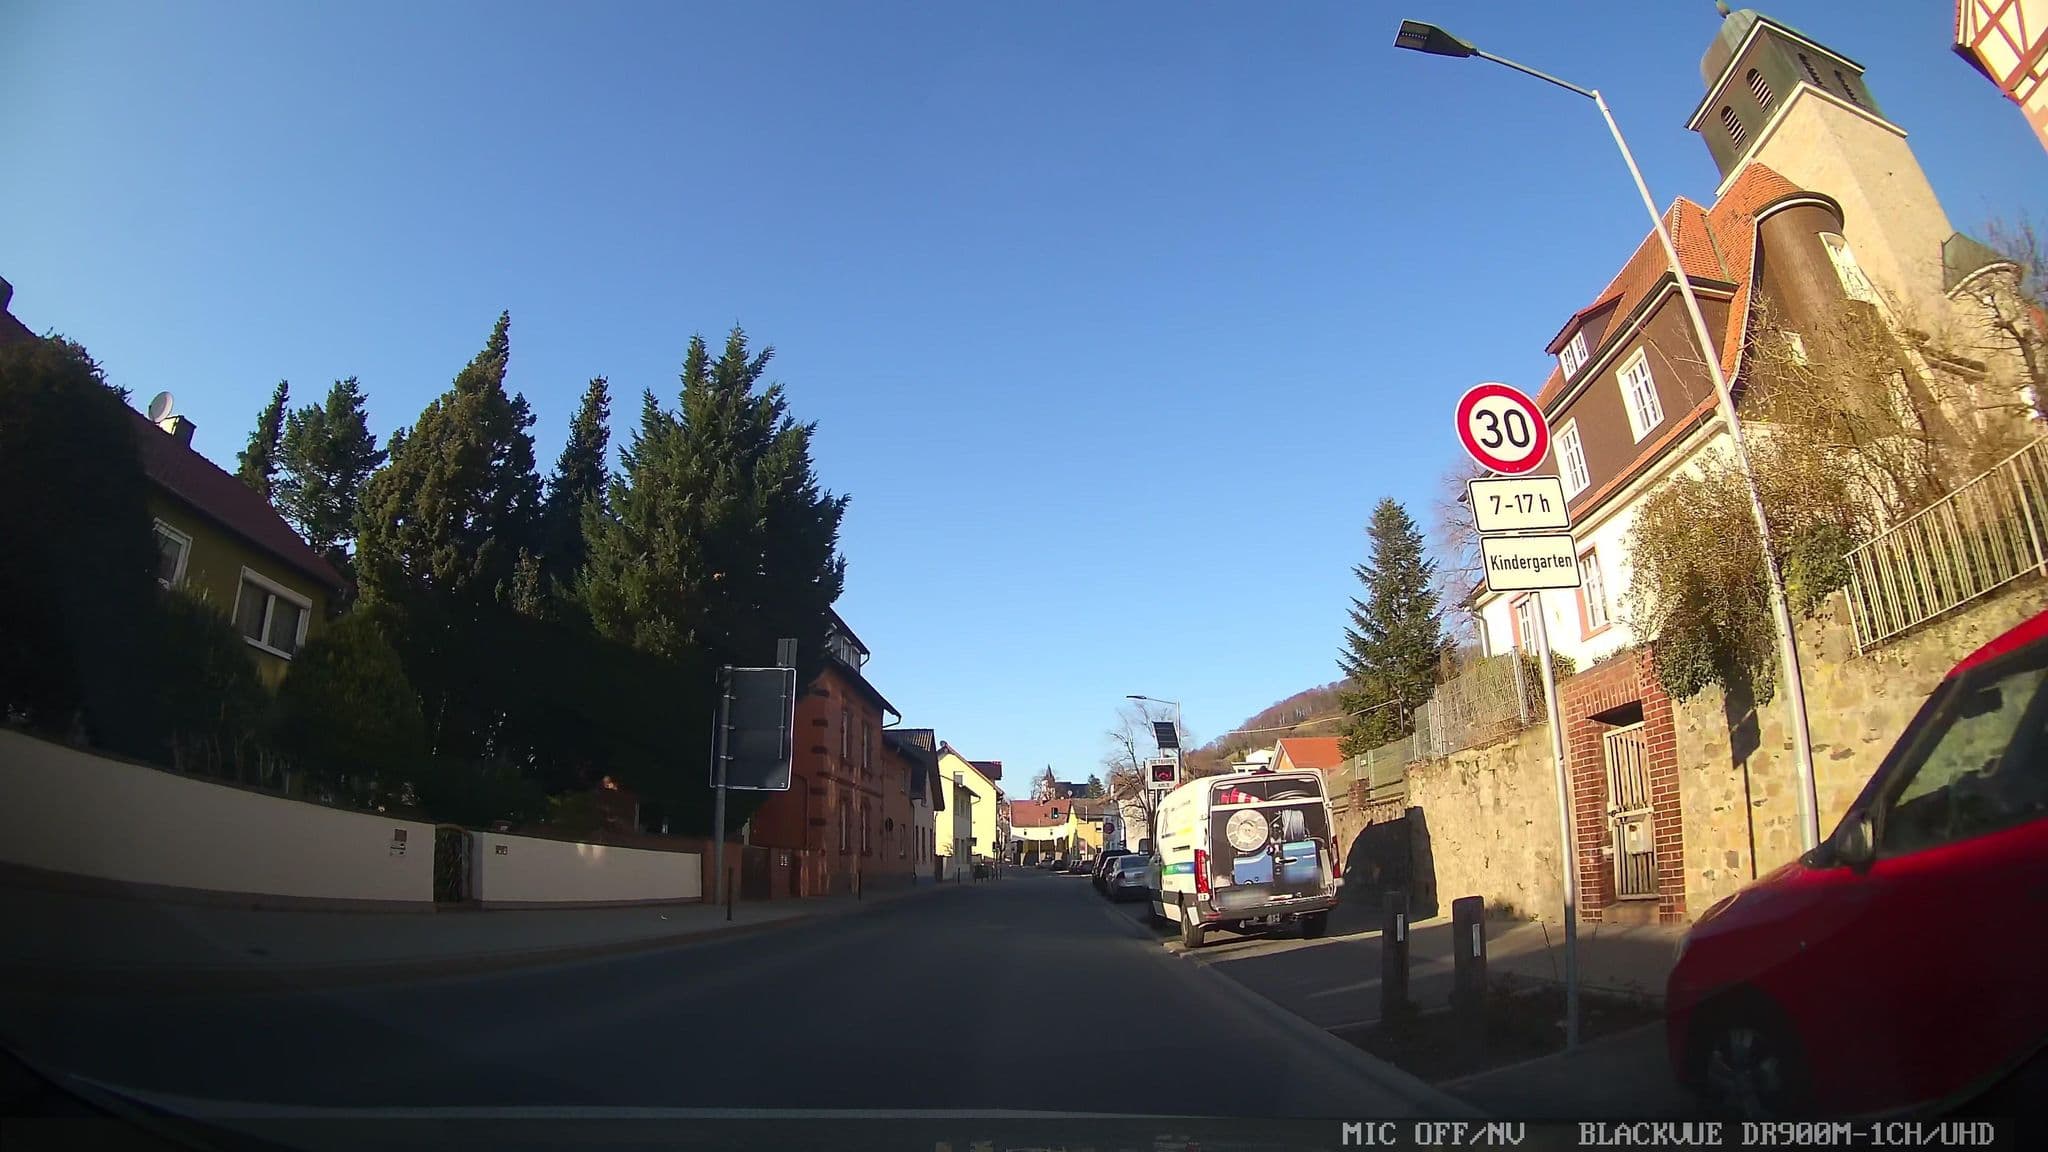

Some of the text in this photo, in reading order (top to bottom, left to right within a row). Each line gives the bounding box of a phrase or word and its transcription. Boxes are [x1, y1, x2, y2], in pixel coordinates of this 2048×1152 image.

[1476, 409, 1529, 448] 30
[1490, 493, 1551, 515] 7-17 h
[1490, 555, 1573, 573] Kindergarten
